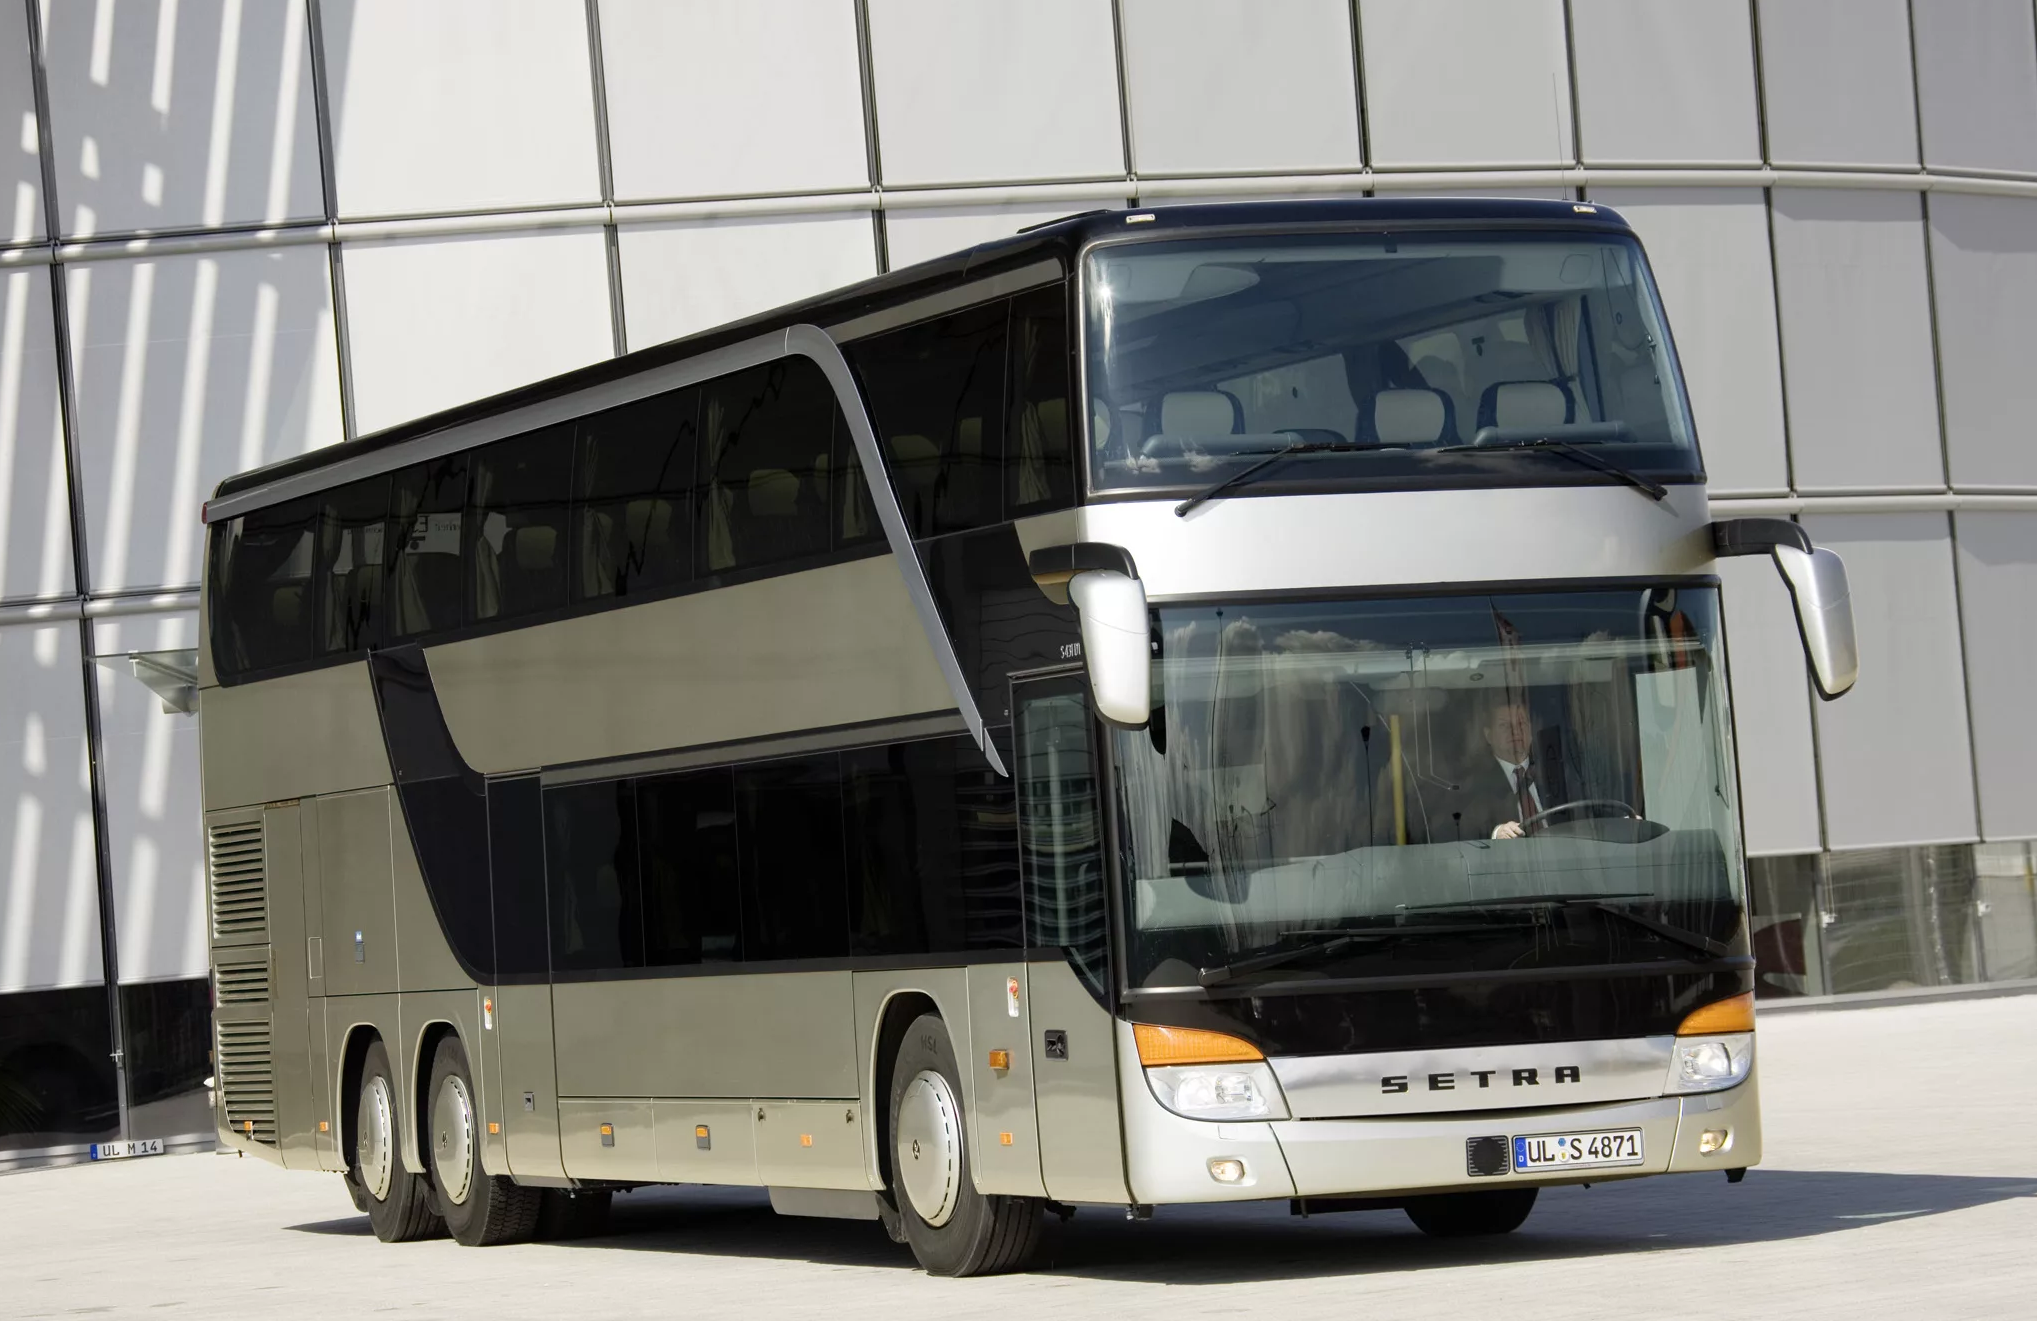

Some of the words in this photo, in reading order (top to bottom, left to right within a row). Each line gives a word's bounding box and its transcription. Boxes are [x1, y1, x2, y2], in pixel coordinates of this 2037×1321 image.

[1381, 1065, 1581, 1094] SETRA
[102, 1145, 119, 1157] UL
[127, 1143, 136, 1154] M
[141, 1141, 157, 1153] 14
[1518, 1155, 1525, 1163] D
[1528, 1140, 1556, 1163] UL
[1570, 1138, 1583, 1161] S
[1588, 1134, 1639, 1159] 4871
